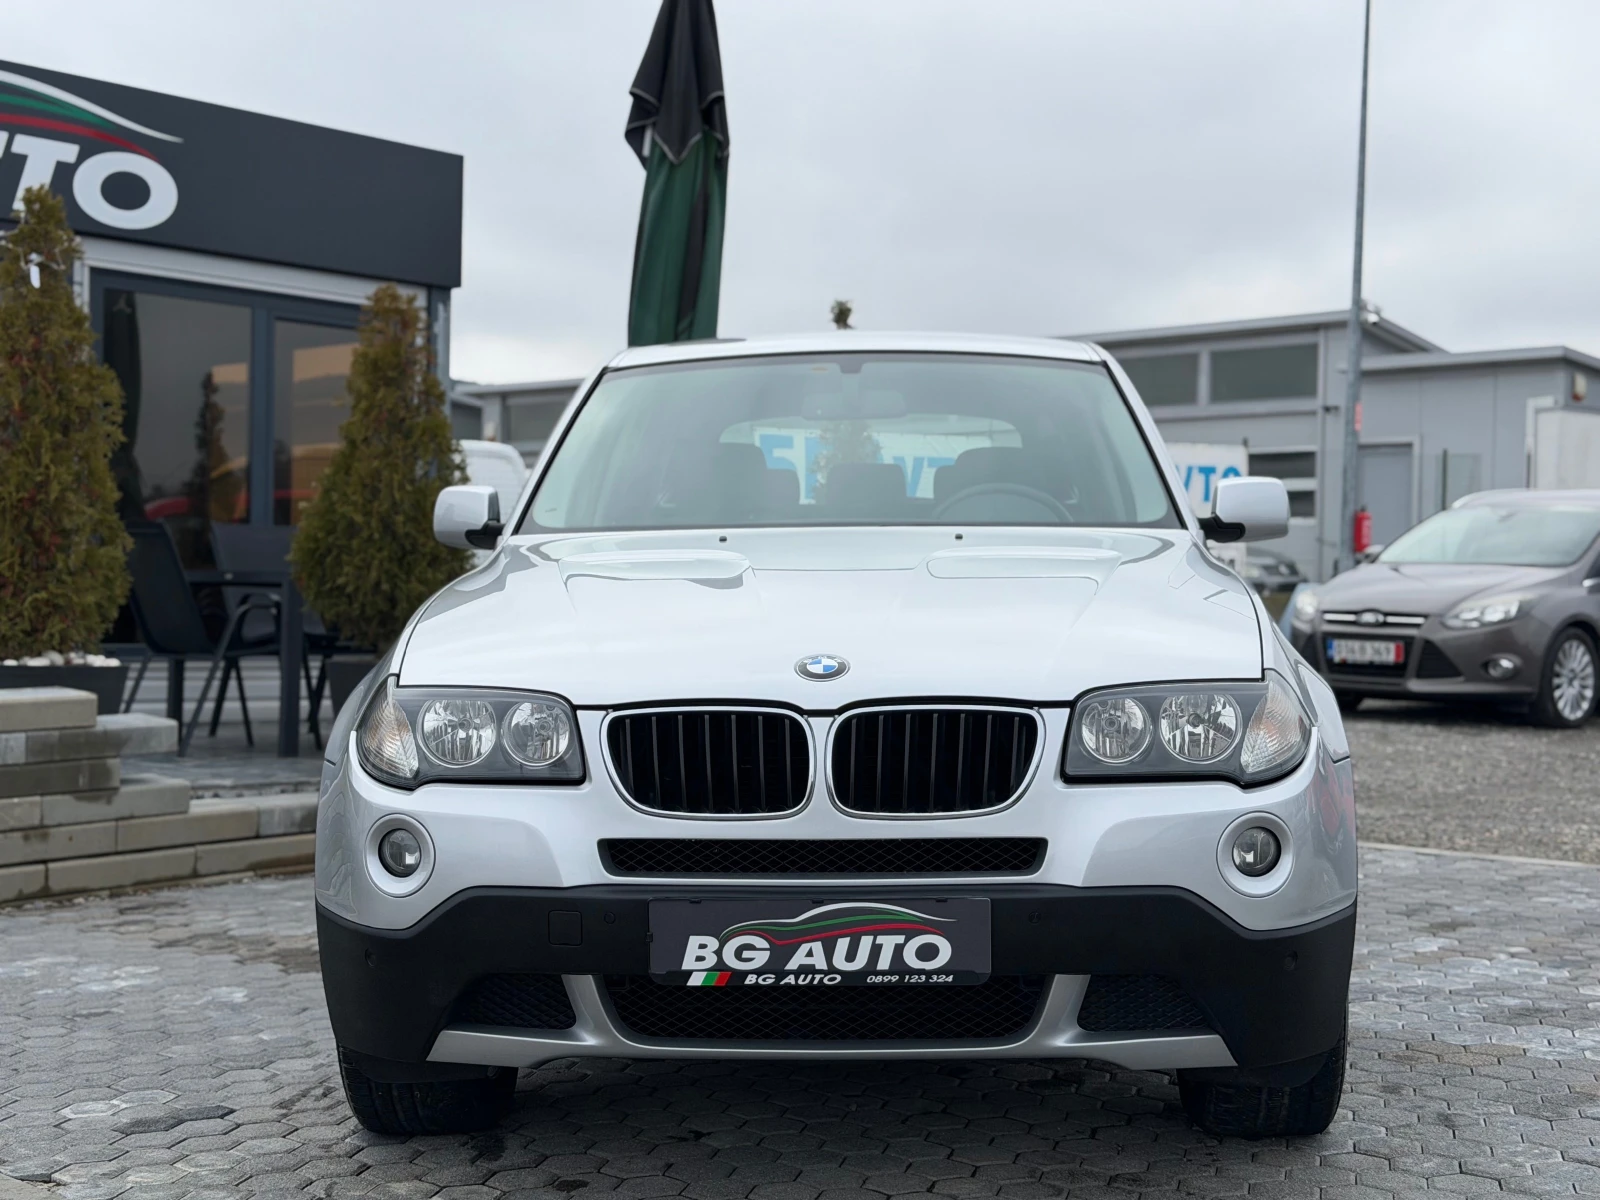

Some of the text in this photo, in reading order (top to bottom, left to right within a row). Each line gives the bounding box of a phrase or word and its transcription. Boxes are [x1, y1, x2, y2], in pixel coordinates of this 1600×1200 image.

[0, 130, 178, 230] TO
[681, 934, 952, 971] BG AUTO
[744, 974, 842, 985] BG AUTO
[866, 974, 954, 983] 0899 123 324
